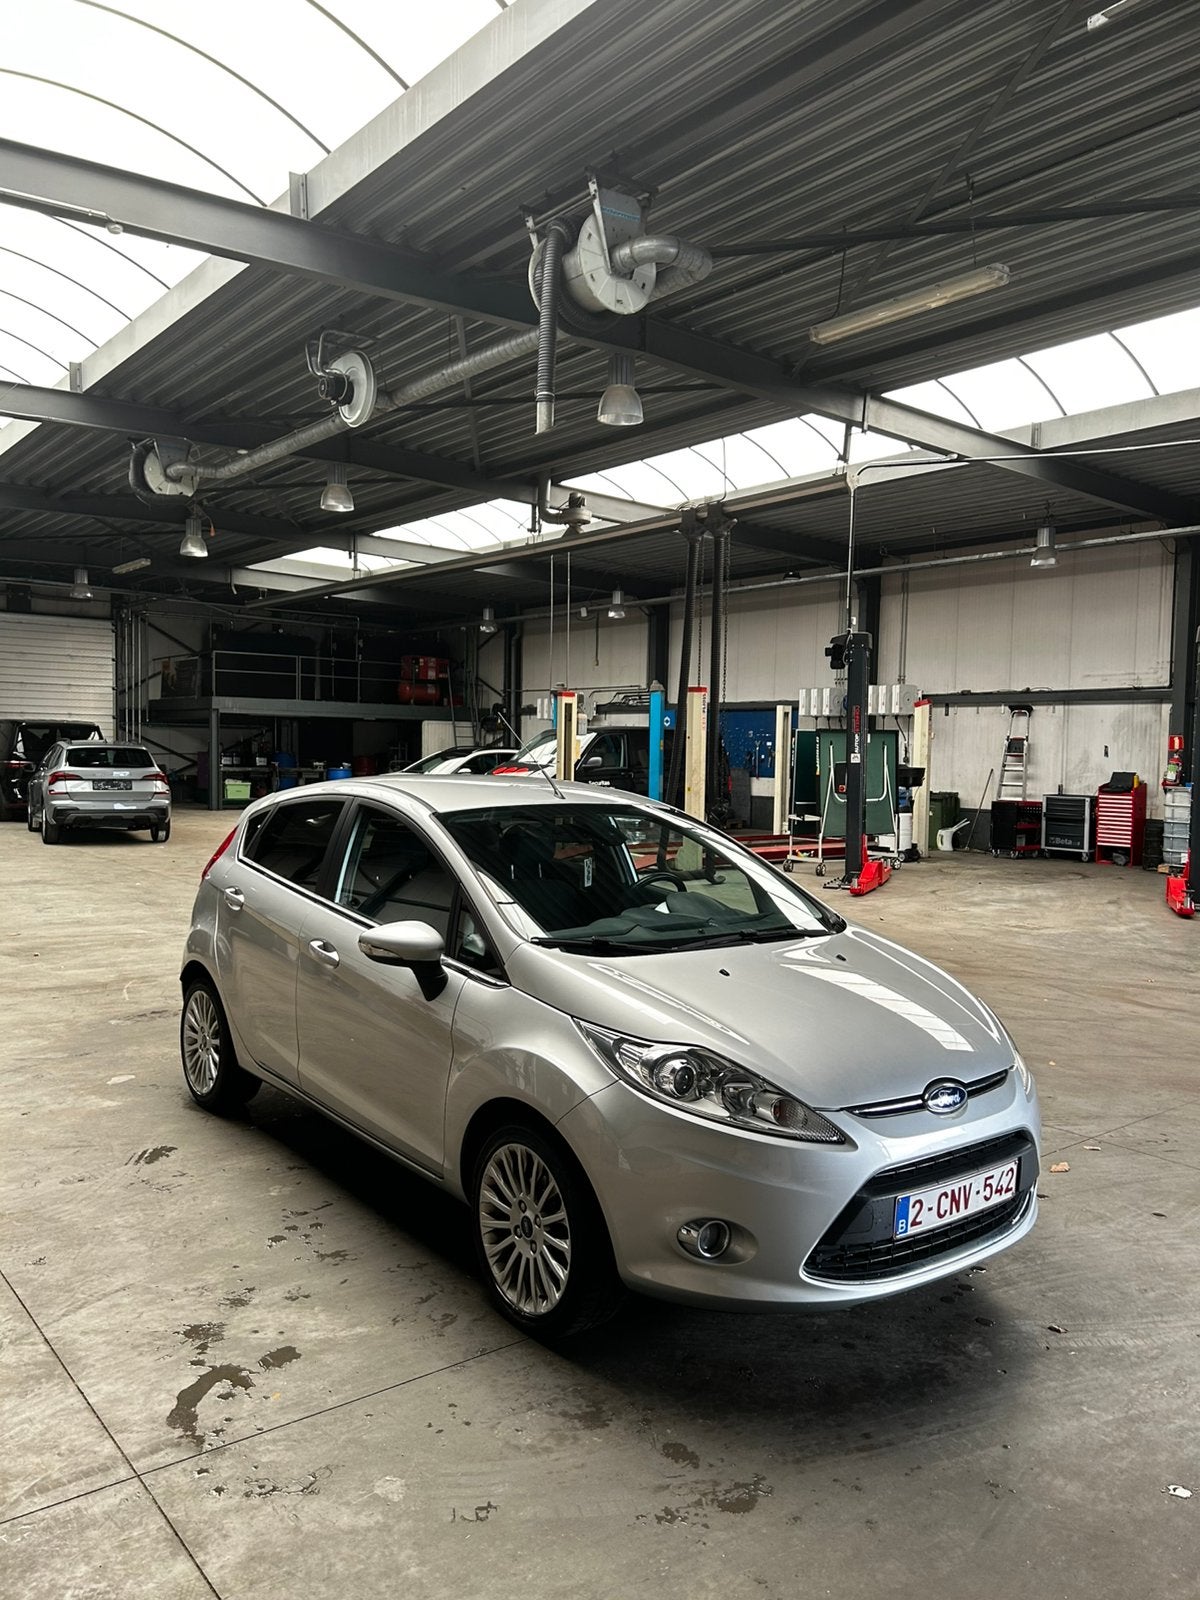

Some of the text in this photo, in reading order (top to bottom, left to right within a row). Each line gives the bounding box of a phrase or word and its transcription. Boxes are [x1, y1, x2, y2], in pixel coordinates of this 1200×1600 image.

[936, 1089, 961, 1107] Ford
[898, 1167, 1014, 1232] B 2-CNV-542
